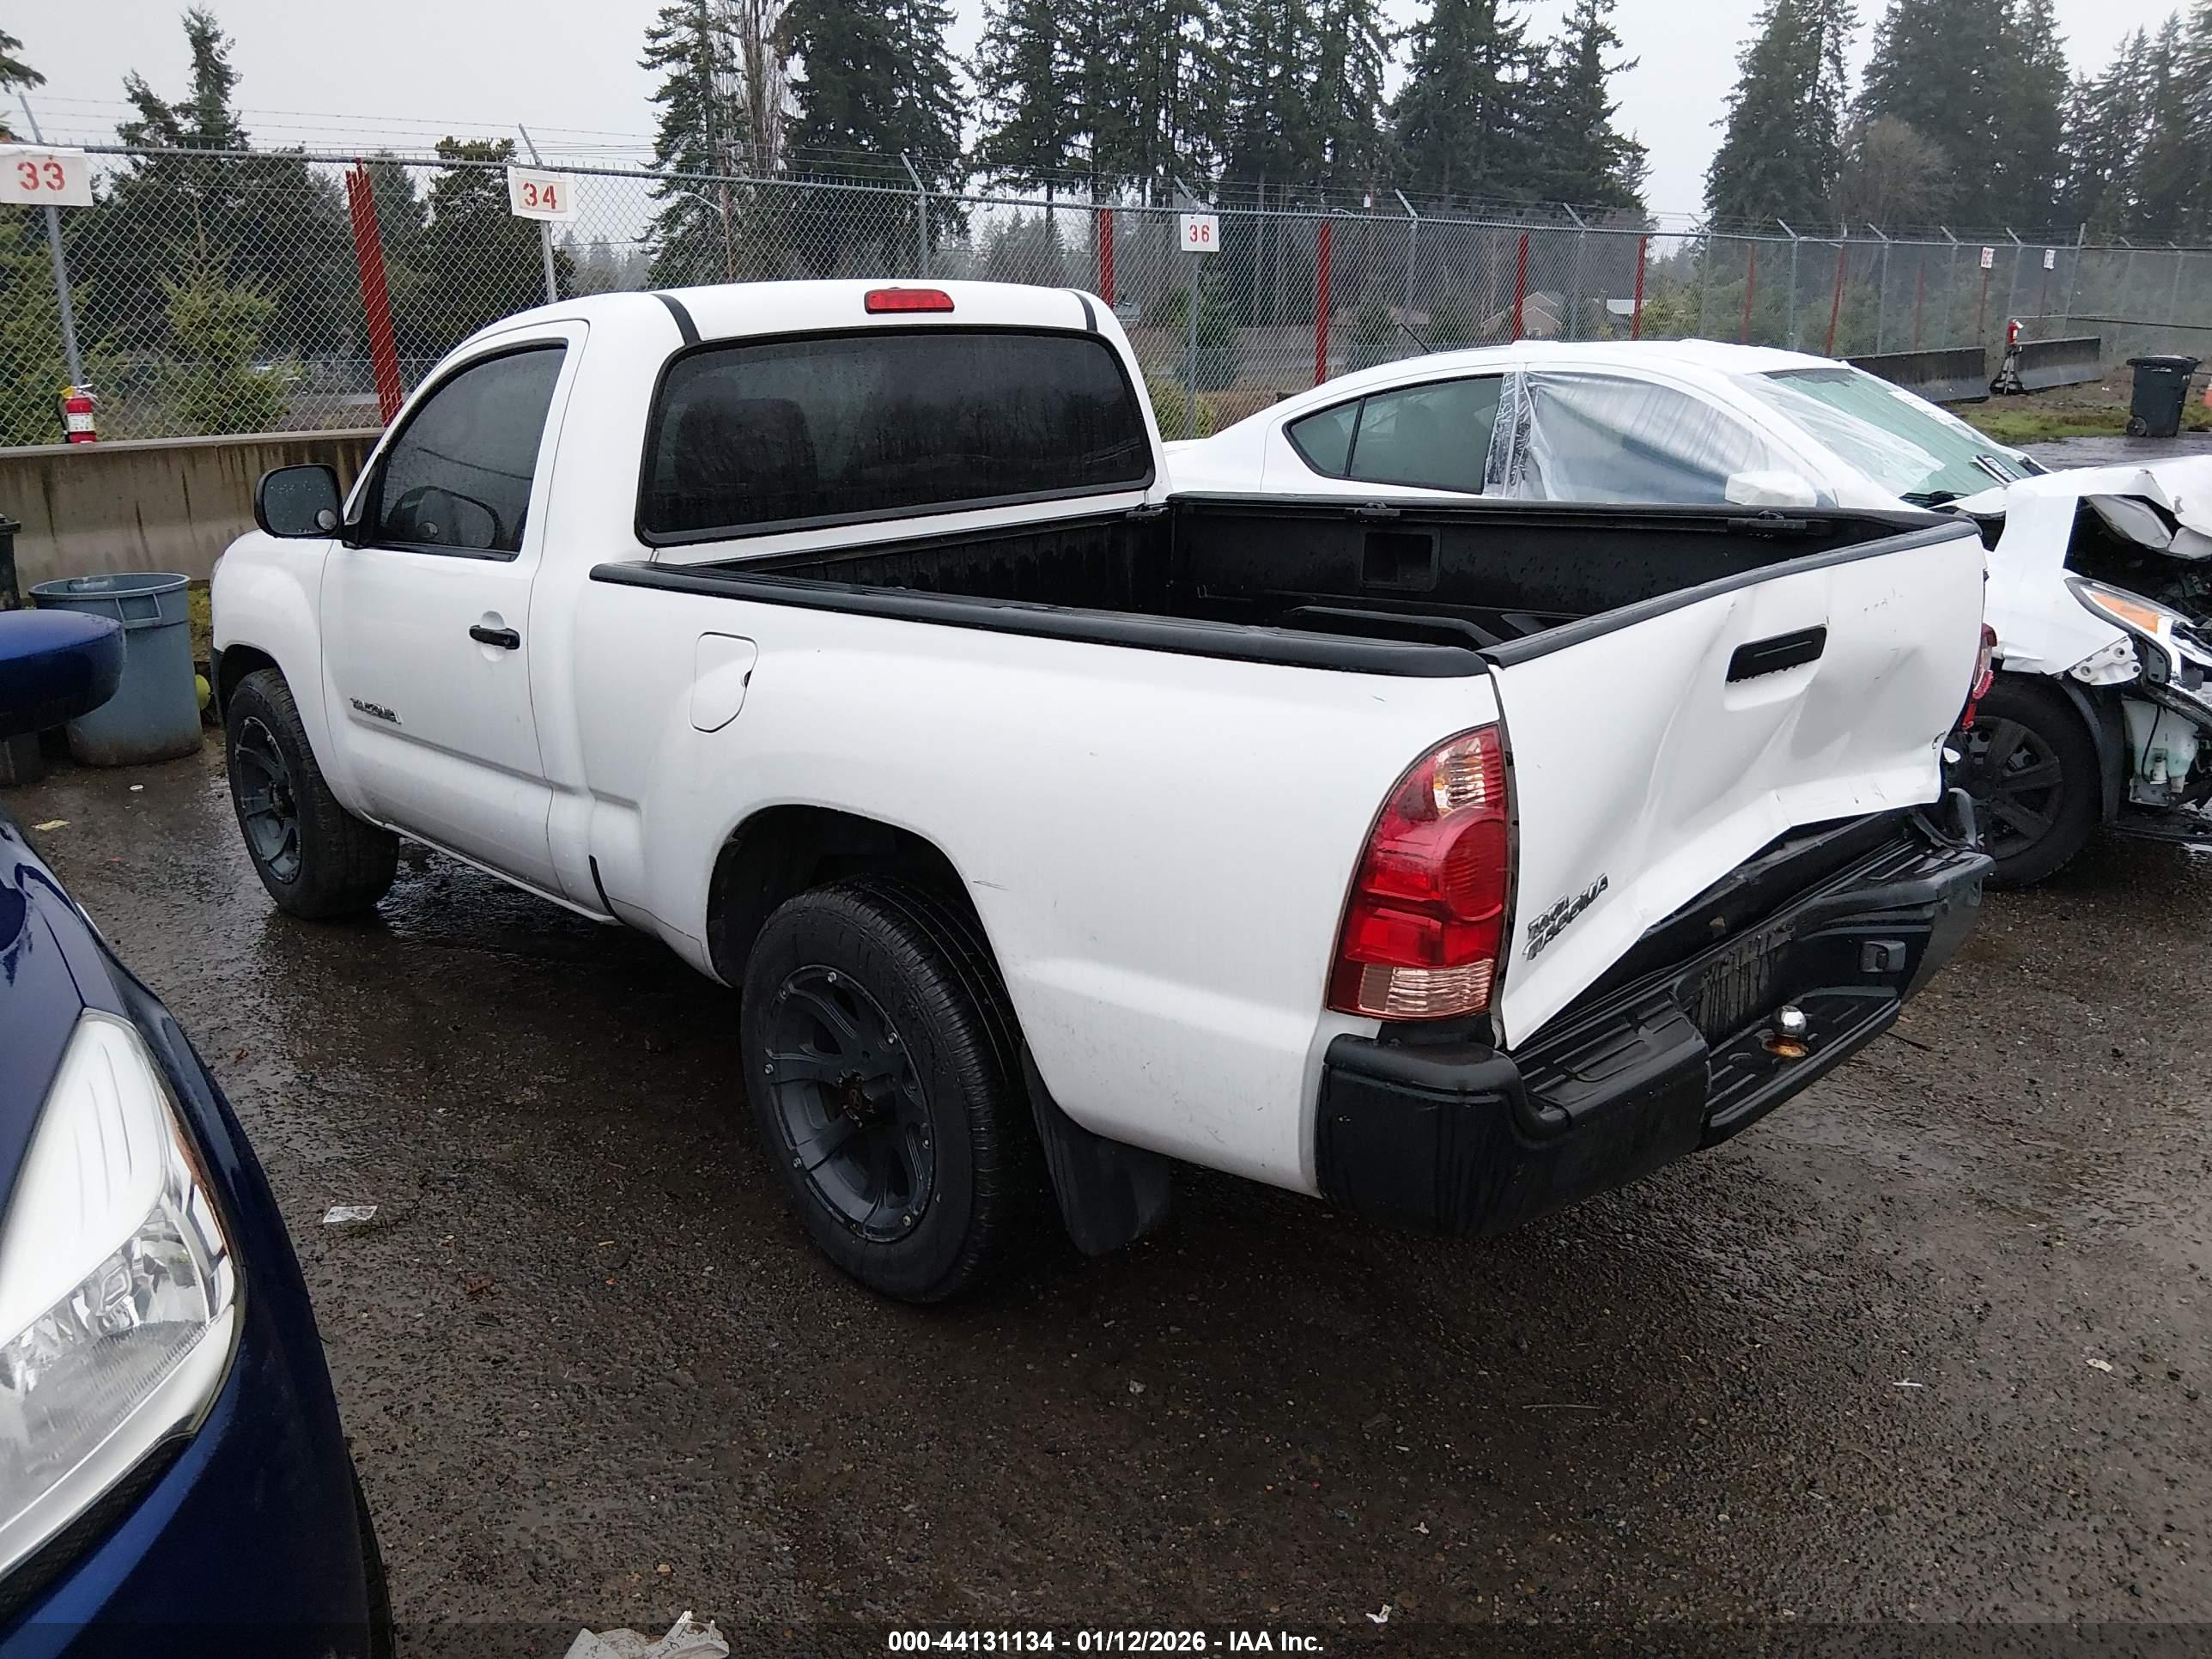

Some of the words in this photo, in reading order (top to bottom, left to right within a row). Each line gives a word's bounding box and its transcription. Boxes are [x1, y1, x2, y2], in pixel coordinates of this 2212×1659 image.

[17, 161, 65, 191] 33
[522, 182, 557, 210] 34
[1188, 223, 1210, 242] 36
